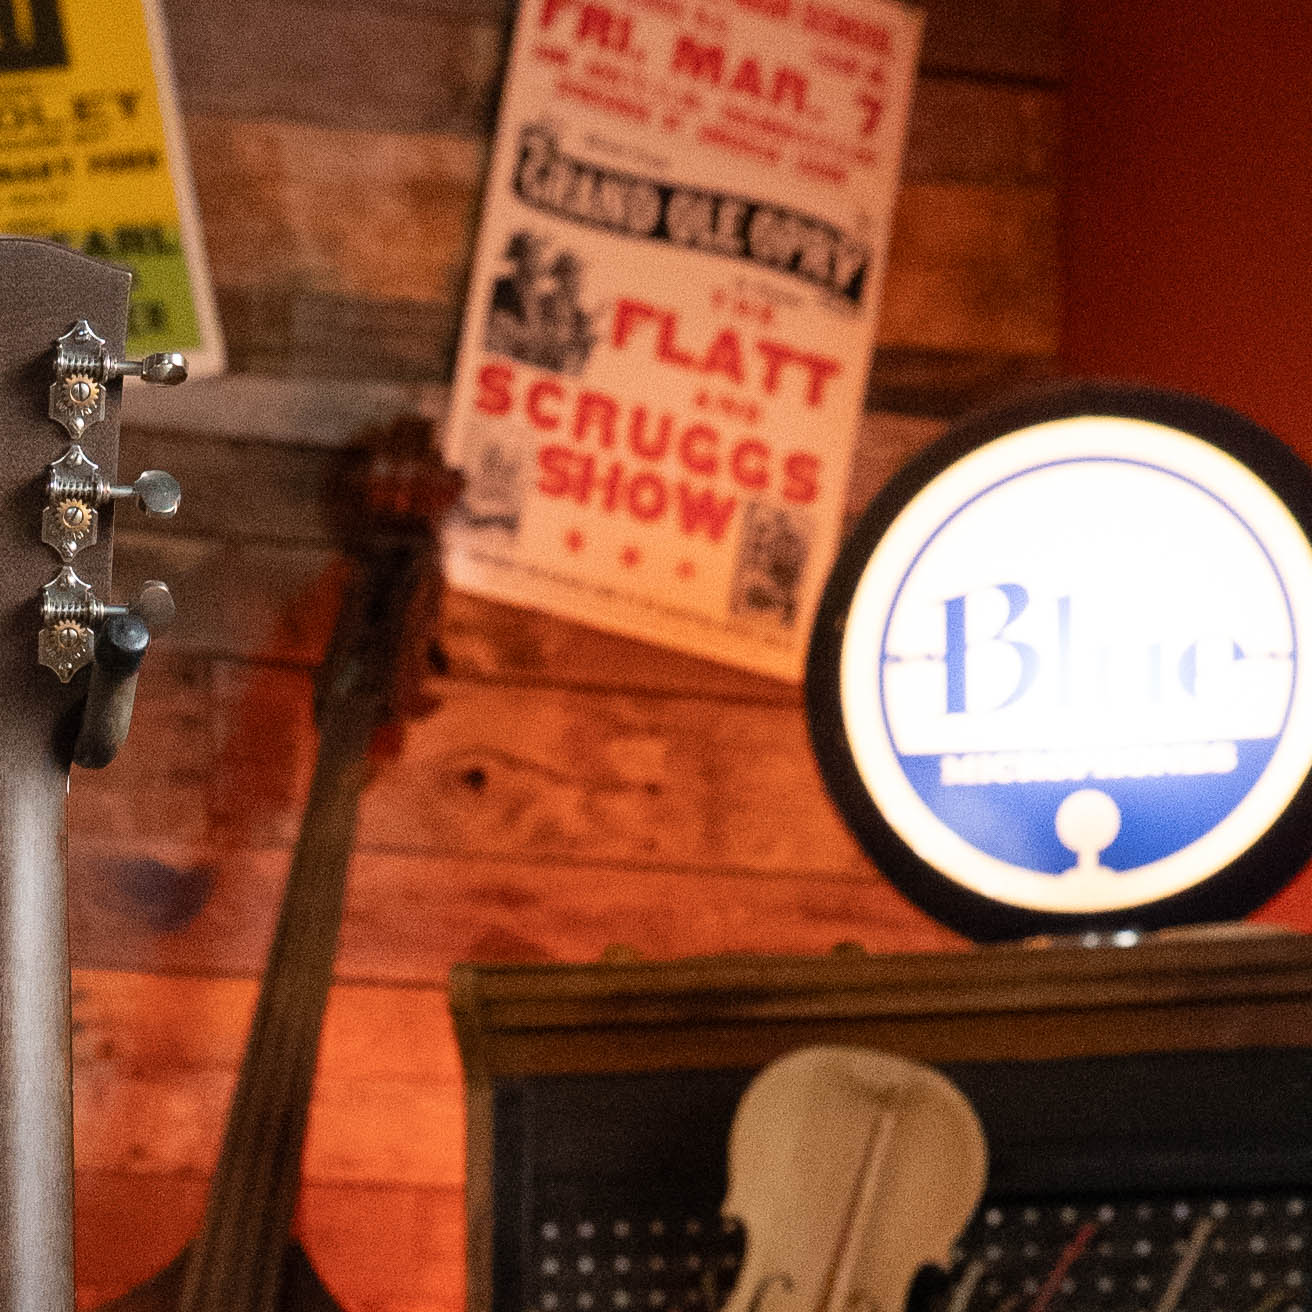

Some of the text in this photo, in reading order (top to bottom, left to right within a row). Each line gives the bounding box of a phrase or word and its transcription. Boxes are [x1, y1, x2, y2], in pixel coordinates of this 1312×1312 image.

[671, 36, 825, 122] MAR.
[613, 299, 843, 408] FLATT
[476, 363, 821, 504] SCRUGGS
[537, 444, 737, 545] SHOW
